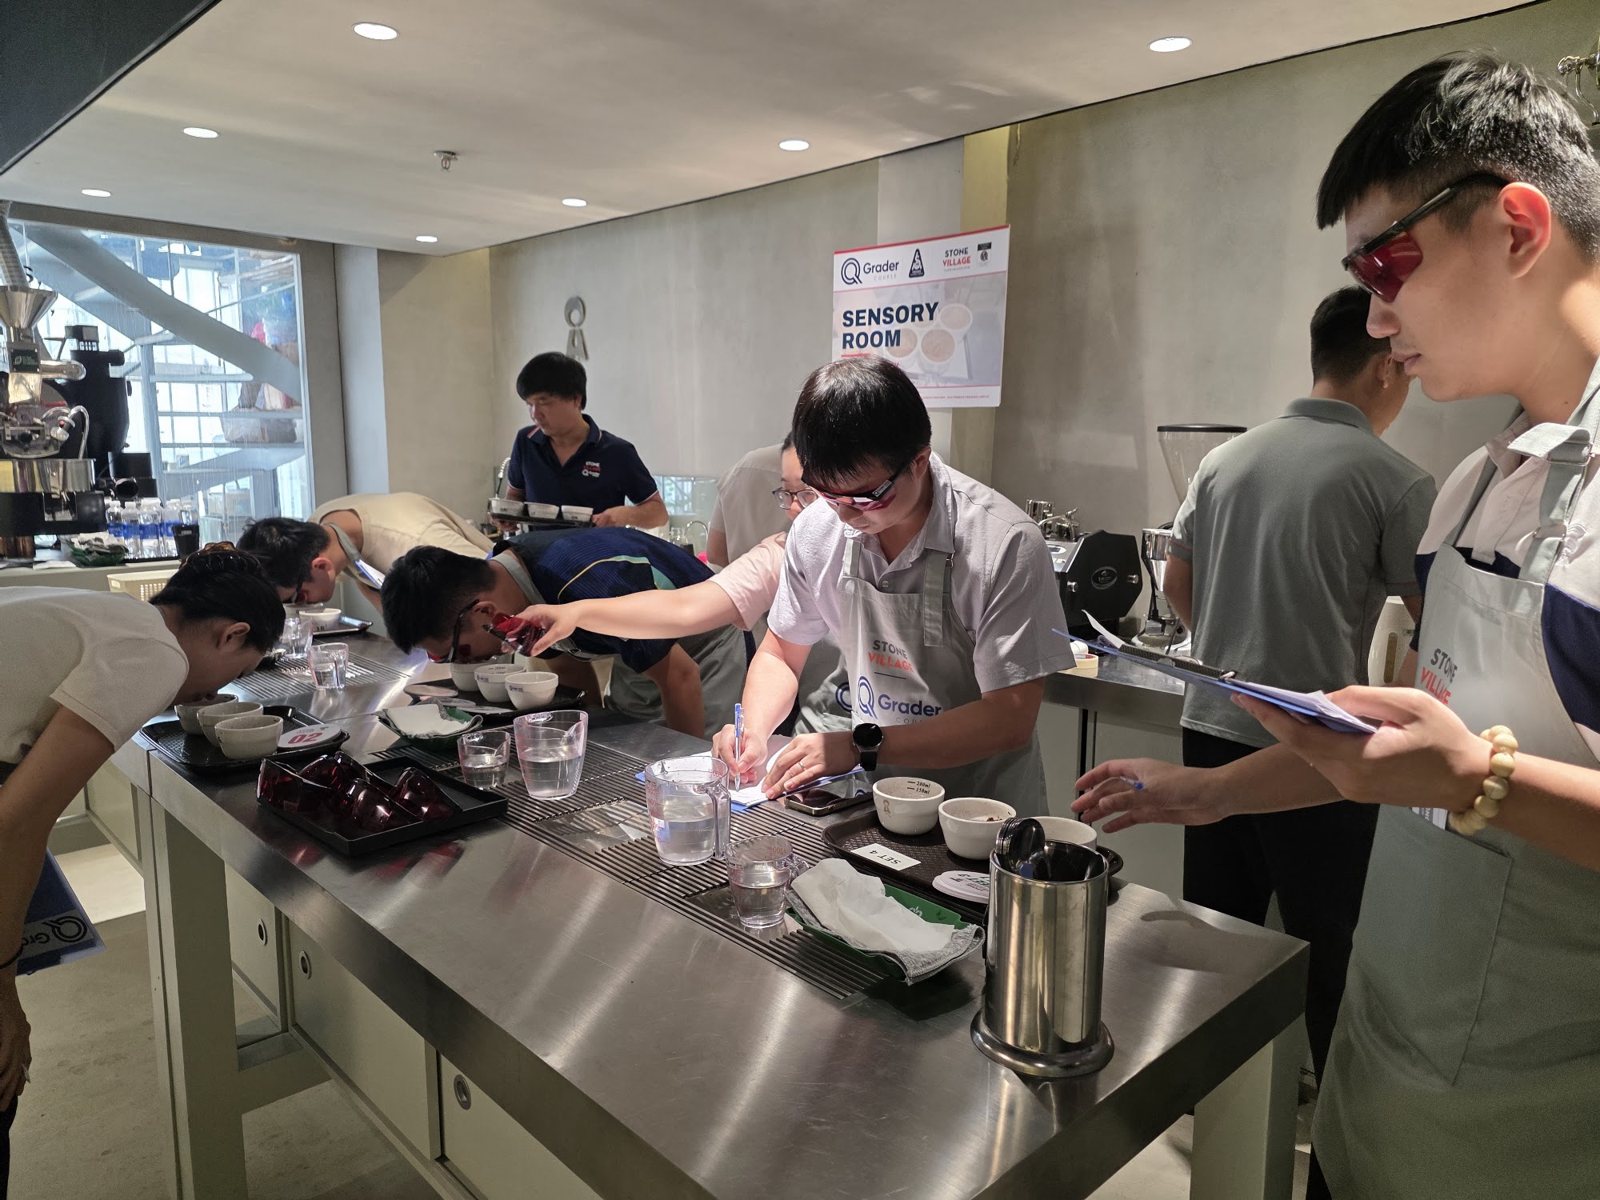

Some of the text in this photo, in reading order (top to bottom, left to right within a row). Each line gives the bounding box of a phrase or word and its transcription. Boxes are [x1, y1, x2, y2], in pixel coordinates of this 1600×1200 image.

[943, 256, 972, 267] VILLAGE
[945, 247, 969, 258] STONE
[841, 258, 900, 285] Q Grader
[842, 302, 939, 327] SENSORY
[842, 329, 901, 349] ROOM
[872, 639, 908, 660] STONE
[1421, 665, 1452, 705] VILLE
[857, 675, 878, 719] Q
[878, 693, 942, 717] Grader
[288, 732, 323, 744] 02
[877, 853, 901, 865] SET
